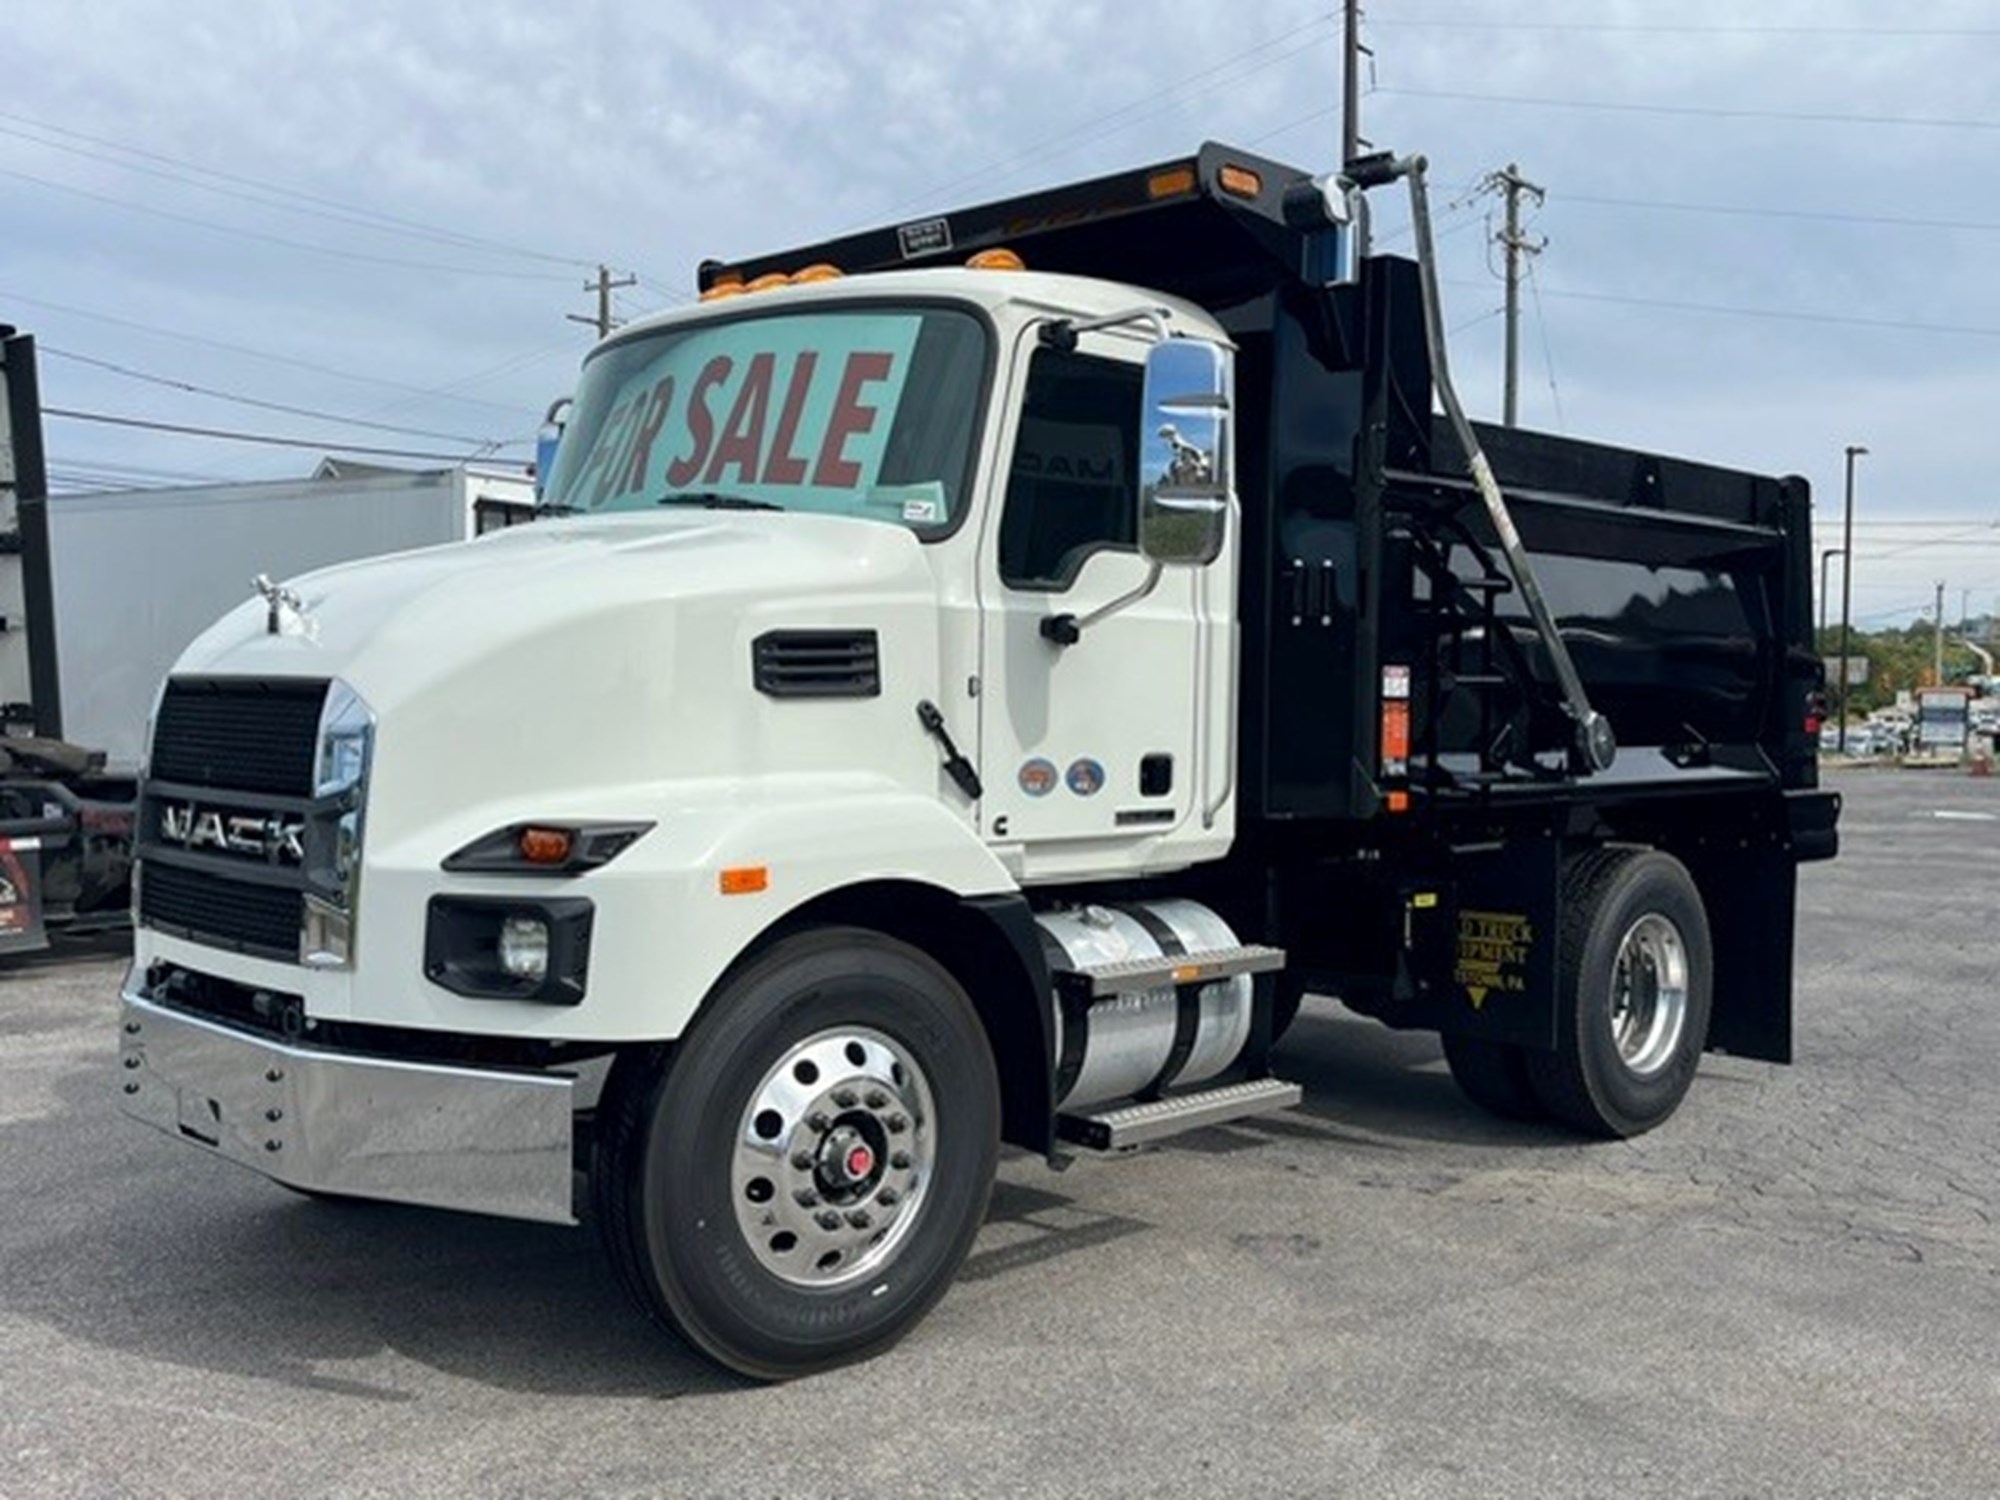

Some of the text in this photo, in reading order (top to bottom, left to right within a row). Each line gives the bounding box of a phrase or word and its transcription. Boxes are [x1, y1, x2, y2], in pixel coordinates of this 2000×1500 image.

[564, 351, 891, 505] FOR SALE
[161, 805, 305, 858] MACK
